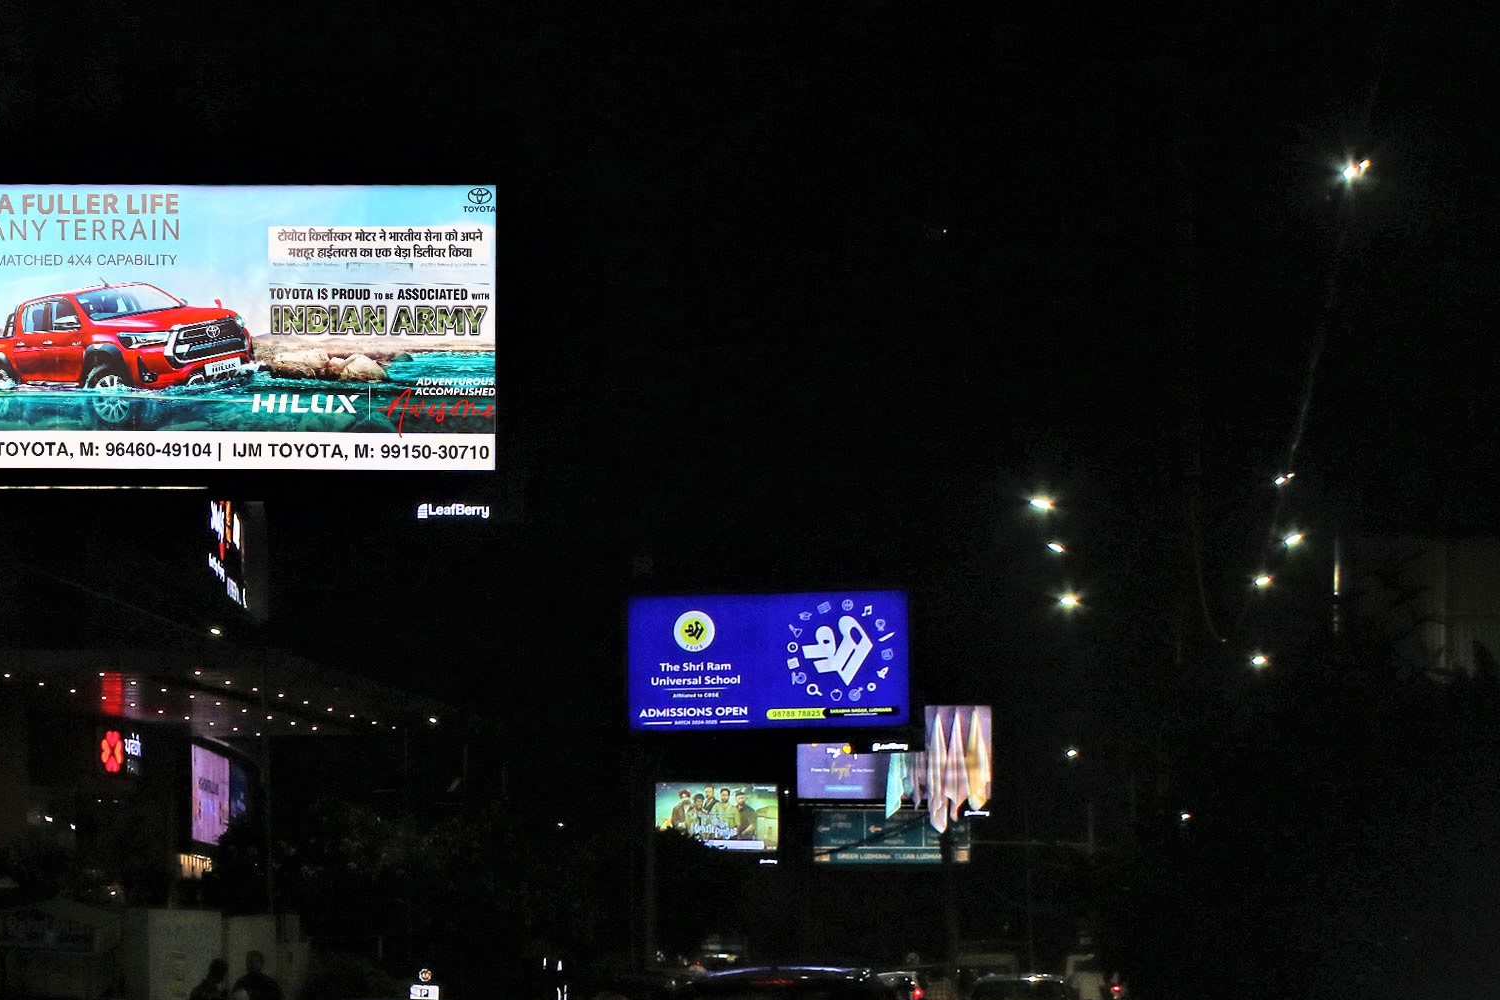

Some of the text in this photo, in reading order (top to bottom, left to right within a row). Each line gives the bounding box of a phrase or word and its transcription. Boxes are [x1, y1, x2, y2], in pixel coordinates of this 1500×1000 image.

[22, 193, 119, 215] FULLER
[126, 193, 180, 215] LIFE
[463, 205, 496, 213] TOYOTA
[56, 219, 180, 241] TERRAIN
[278, 228, 306, 242] टोयोटा
[355, 228, 376, 242] मोटर
[379, 228, 387, 242] ने
[388, 228, 422, 242] भारतीय
[424, 228, 442, 242] सेना
[445, 228, 458, 242] को
[460, 228, 483, 242] अपने
[288, 247, 315, 260] मशहूर
[360, 247, 373, 258] का
[375, 247, 392, 258] एक
[394, 245, 411, 259] बेड़ा
[413, 244, 446, 258] डिलीवर
[448, 244, 473, 258] किया
[67, 254, 92, 266] 4X4
[96, 254, 178, 266] CAPABILITY
[269, 287, 490, 300] TOYOTA IS PROUD TO BE ASSOCIATED WITH
[270, 304, 489, 336] INDIAN ARMY
[414, 387, 496, 397] ACCOMPLISHED
[251, 393, 360, 414] HILUX
[80, 442, 100, 457] M:
[105, 442, 212, 458] 96460-49104
[232, 443, 263, 458] IJM
[268, 443, 349, 461] TOYOTA,
[354, 444, 375, 459] M:
[381, 444, 490, 460] 99150-30710
[428, 503, 490, 519] LeafBerry
[659, 662, 732, 672] The Shri Ram
[650, 674, 741, 686] Universal School
[639, 706, 748, 718] ADMISSIONS OPEN
